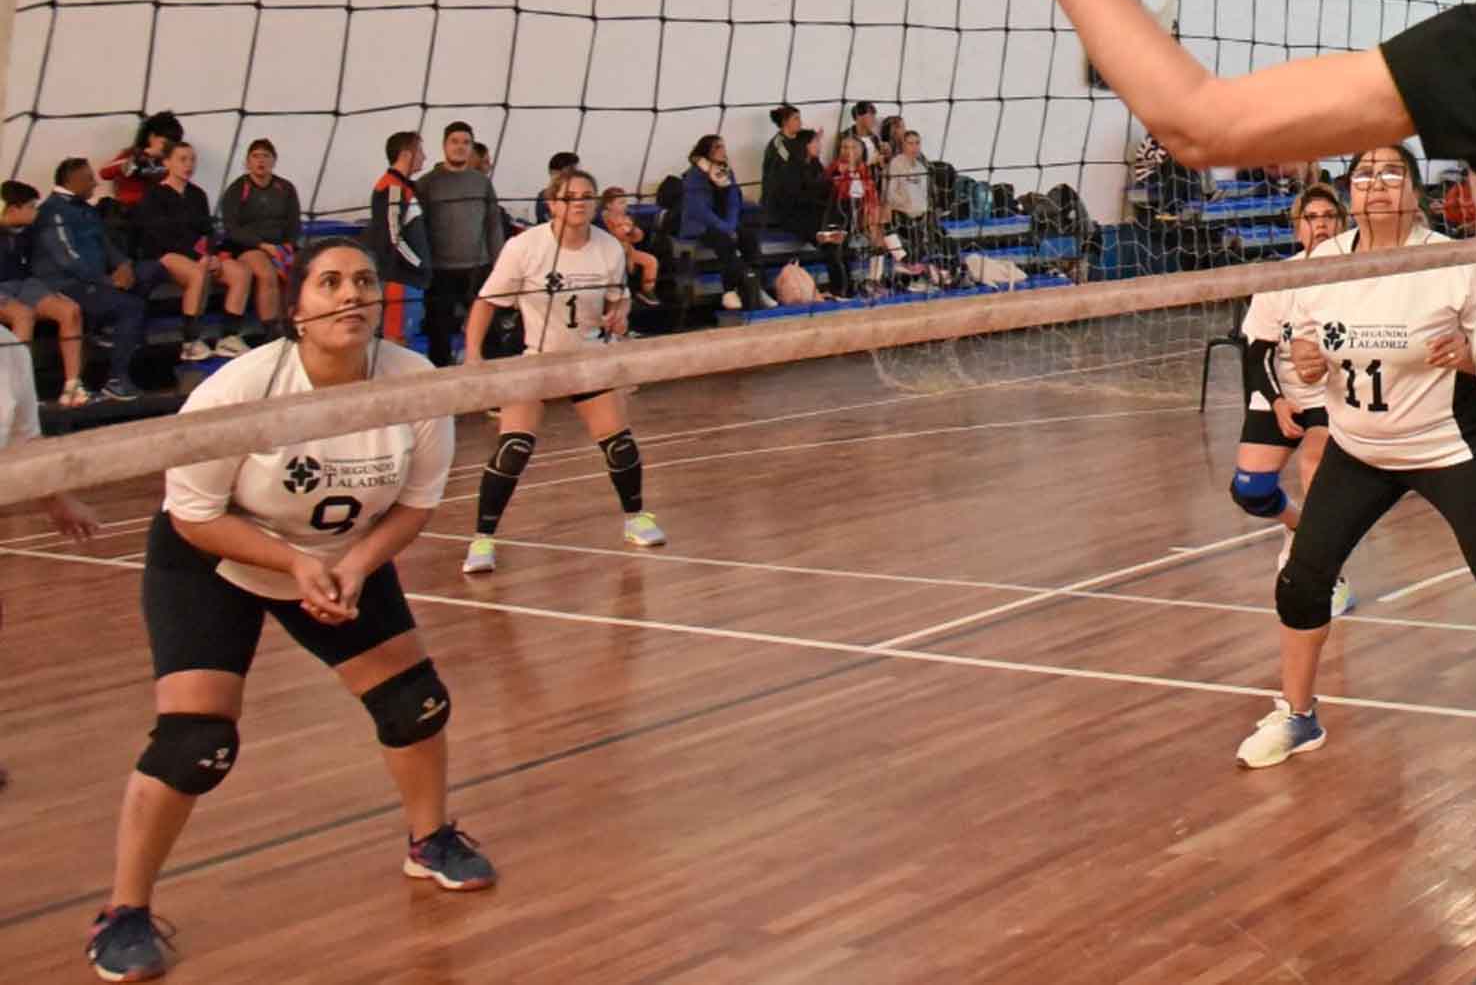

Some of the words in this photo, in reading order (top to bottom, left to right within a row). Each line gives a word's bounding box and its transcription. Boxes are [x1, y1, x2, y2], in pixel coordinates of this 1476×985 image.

[565, 294, 579, 329] 1
[1348, 336, 1408, 349] TALADRIZ
[1341, 359, 1389, 412] 11
[324, 473, 400, 488] TALADRIZ
[310, 495, 363, 534] 9
